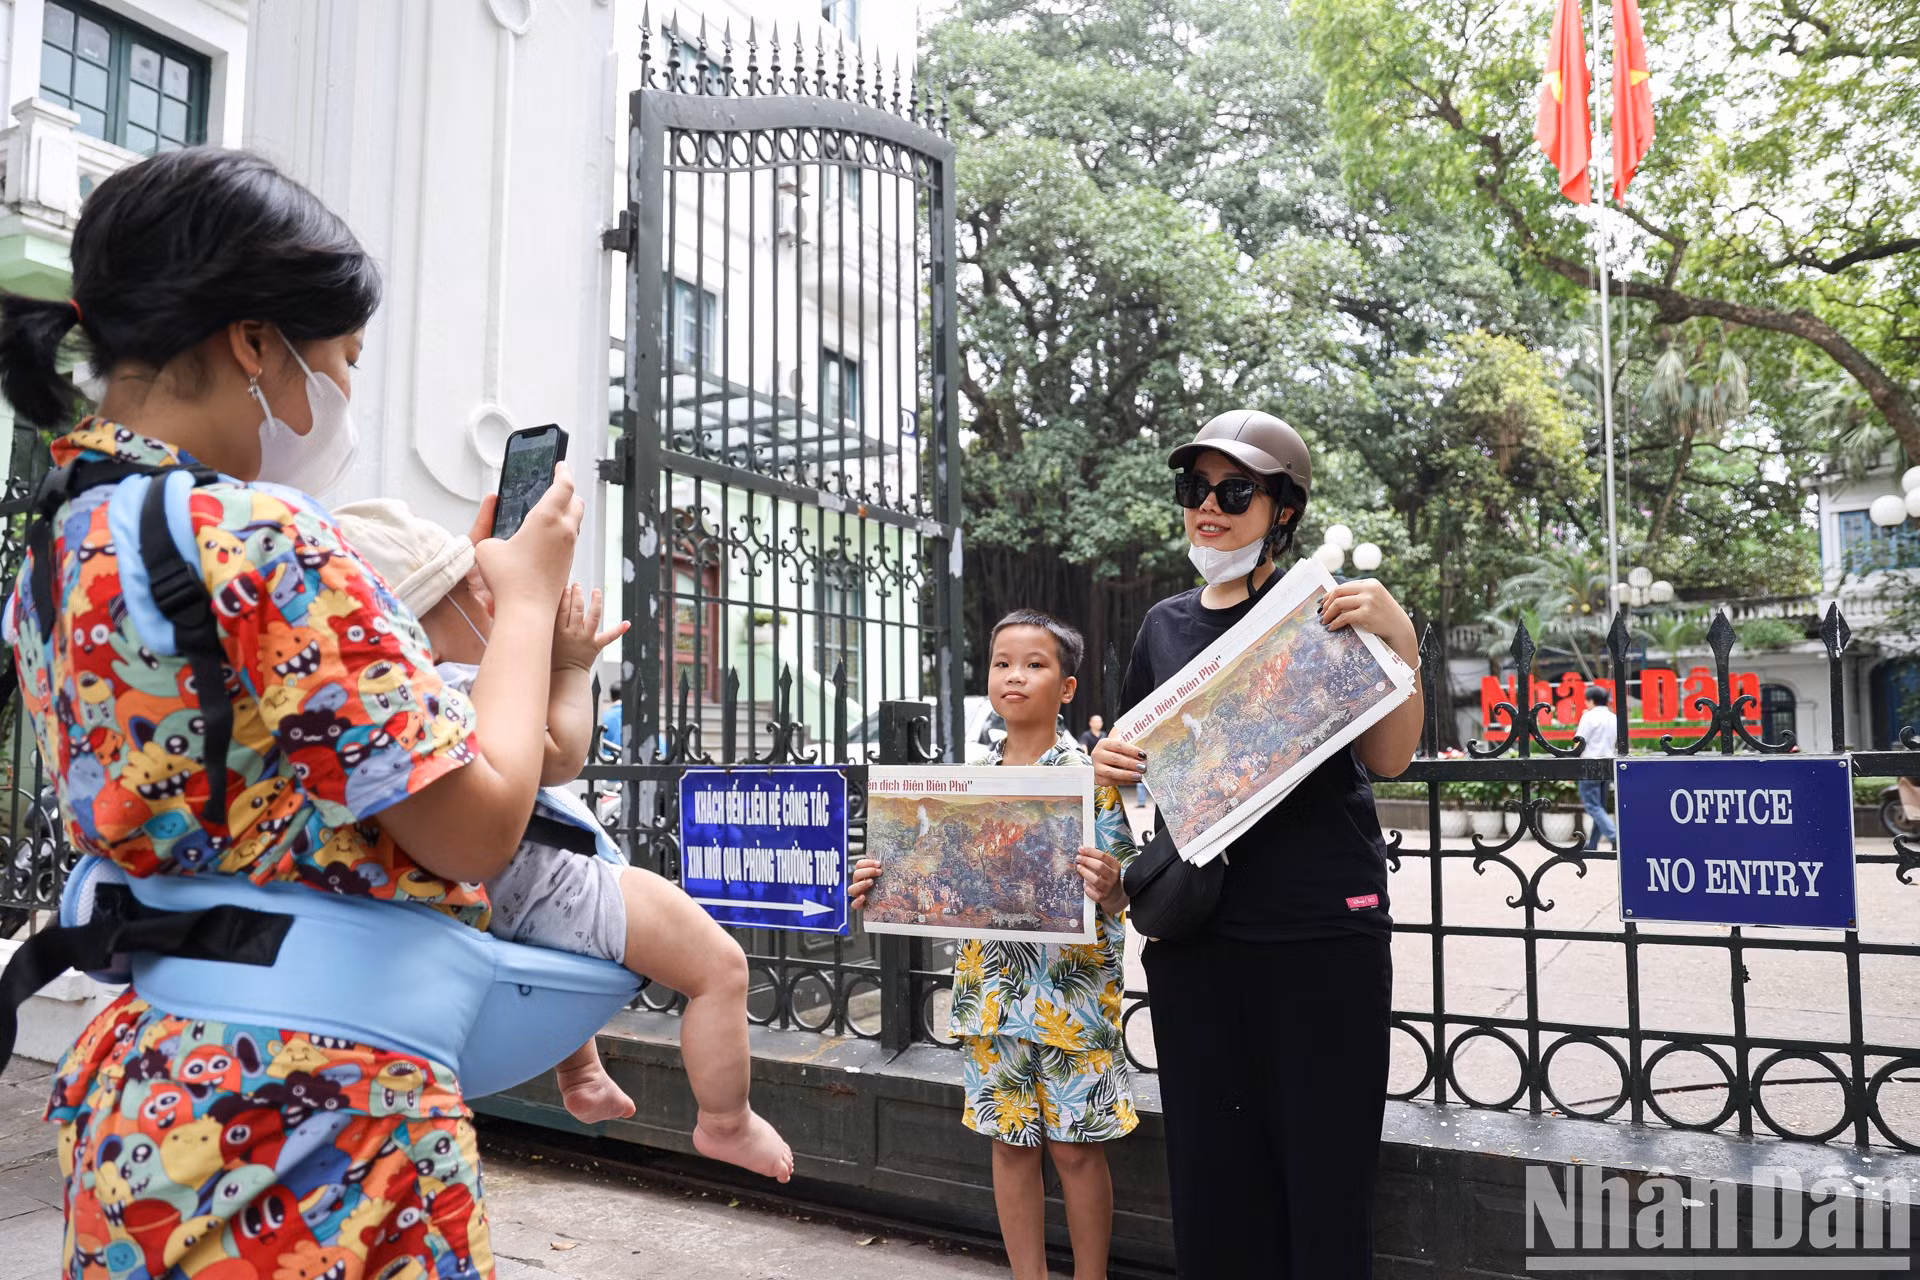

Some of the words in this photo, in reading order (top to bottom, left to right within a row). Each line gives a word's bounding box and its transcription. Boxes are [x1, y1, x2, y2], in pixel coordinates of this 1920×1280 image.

[1176, 677, 1200, 699] Biên
[1641, 666, 1762, 722] Dân
[694, 783, 725, 825] KHÁCH
[726, 779, 744, 825] ĐẾN
[746, 784, 767, 826] LIÊN
[769, 784, 781, 831] HỆ
[783, 784, 809, 827] CÔNG
[810, 784, 830, 827] TÁC
[879, 779, 900, 793] dịch
[903, 779, 924, 794] Điện
[926, 780, 947, 792] Biên
[1670, 788, 1793, 825] OFFICE
[687, 846, 703, 879] XIN
[704, 838, 722, 880] MỜI
[723, 847, 742, 884] QUA
[743, 839, 774, 883] PHÒNG
[775, 840, 813, 885] THƯỜNG
[815, 847, 840, 894] TRỰC
[1646, 857, 1696, 894] NO
[1704, 859, 1824, 897] ENTRY
